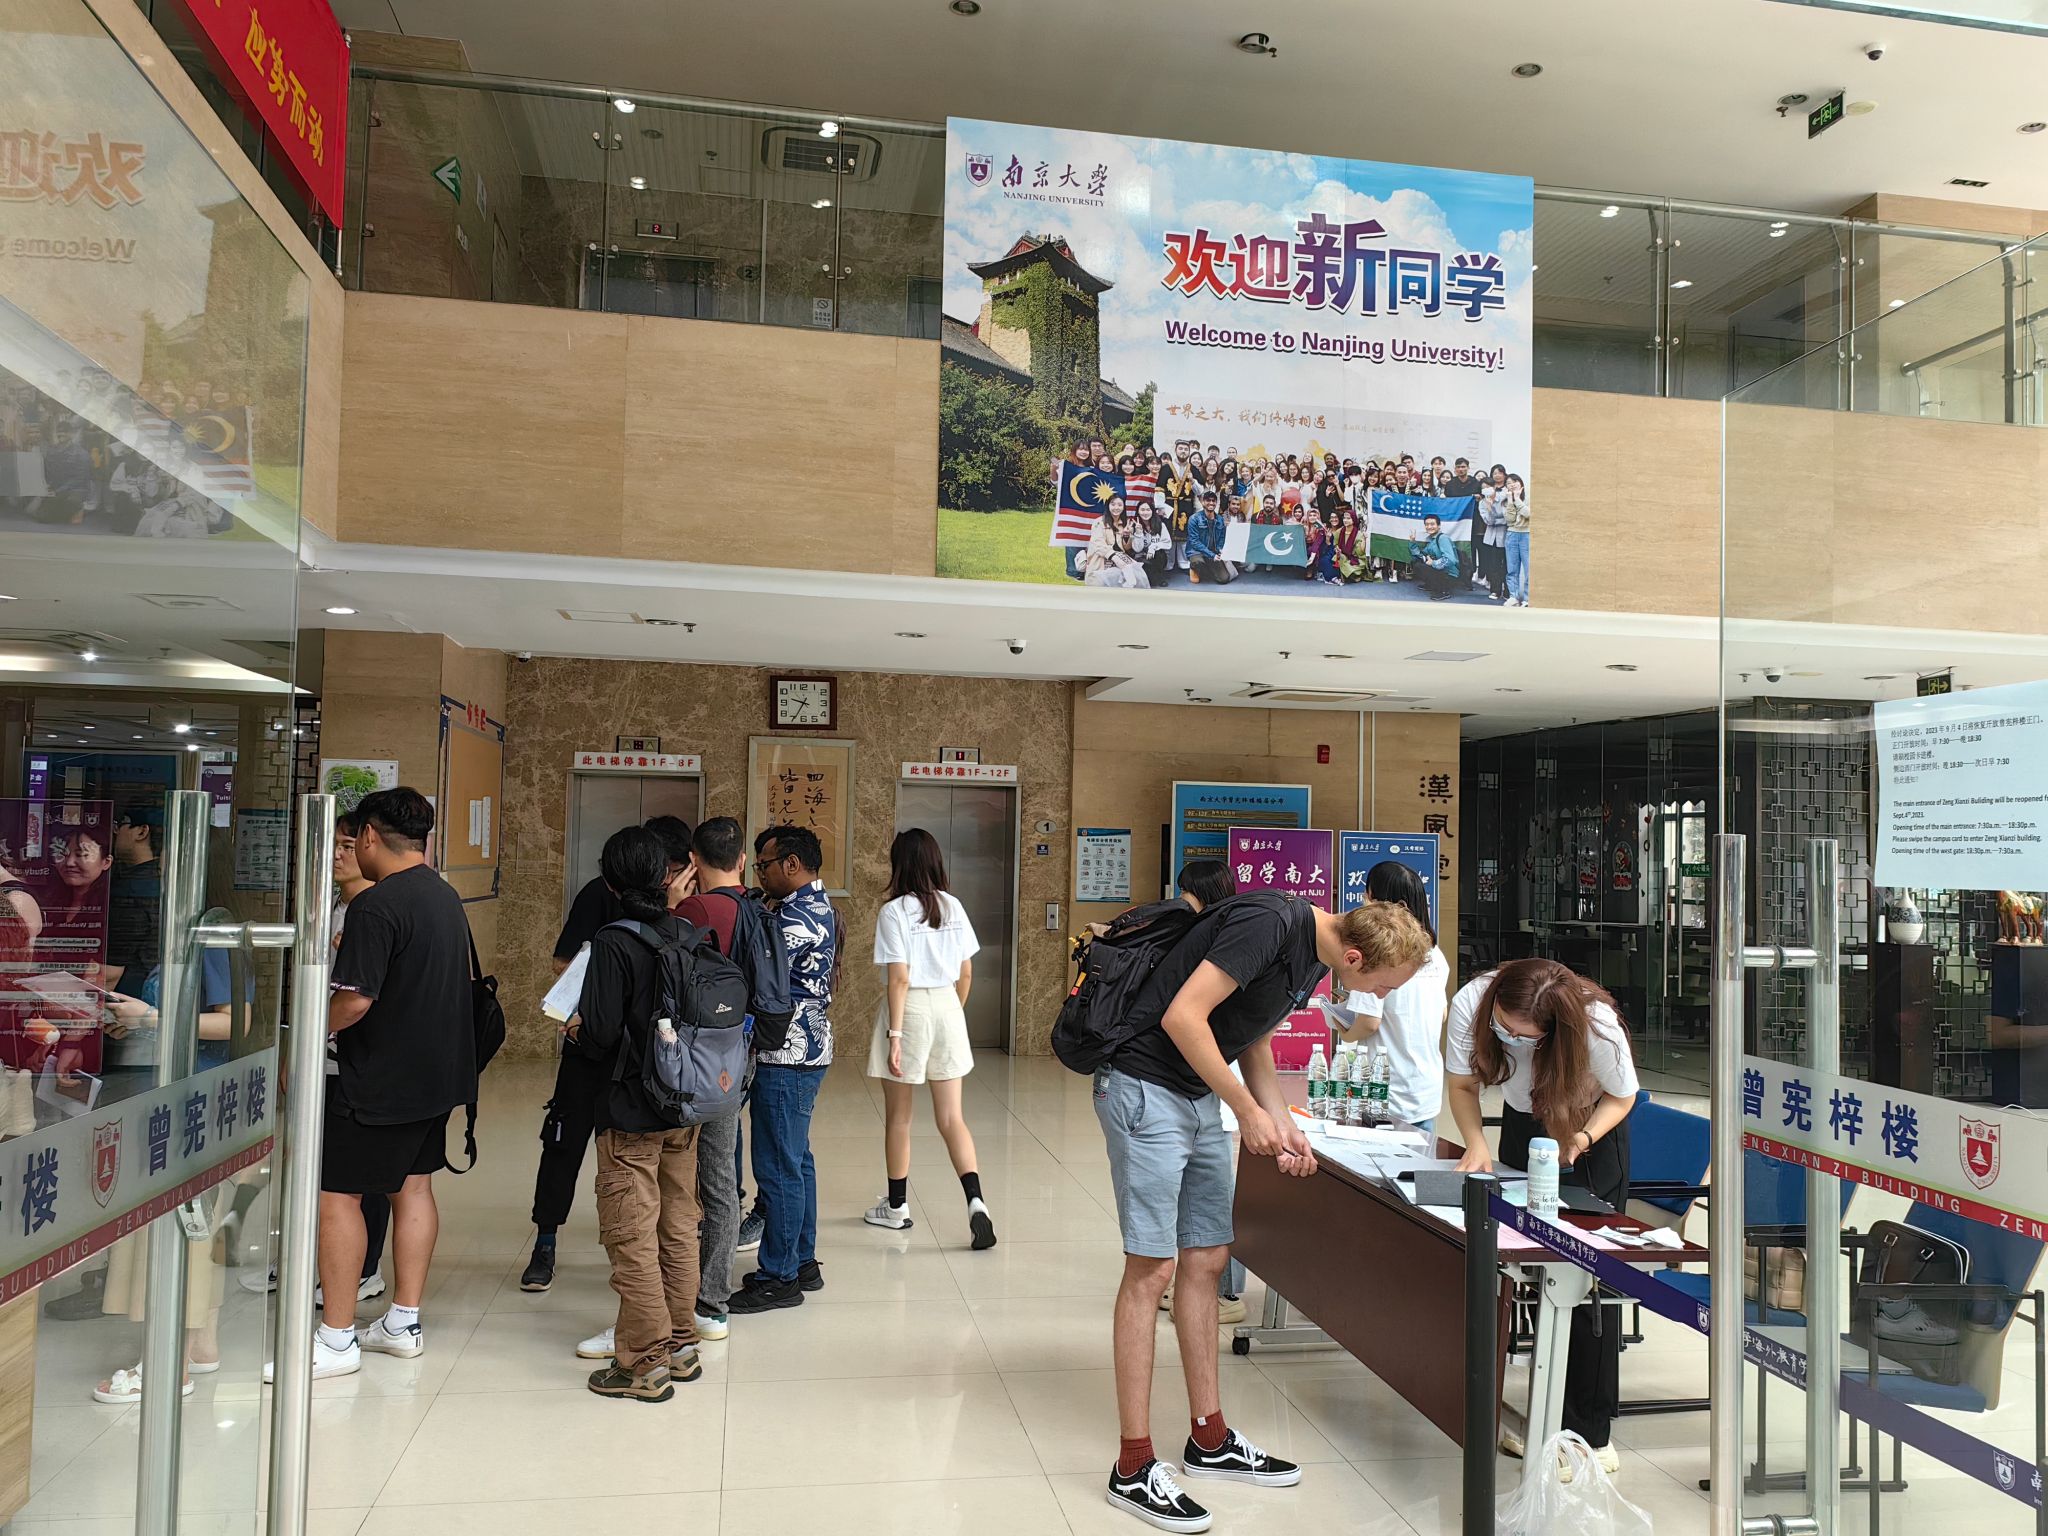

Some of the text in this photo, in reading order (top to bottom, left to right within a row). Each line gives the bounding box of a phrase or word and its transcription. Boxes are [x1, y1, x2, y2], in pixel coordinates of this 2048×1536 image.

[1003, 191, 1105, 207] NANJING UNIVERSITY
[1163, 212, 1506, 321] 欢迎新同学
[1165, 320, 1505, 370] Welcome to Nanjing University!
[910, 765, 1010, 777] 此电梯停靠1F-12F
[1916, 799, 1935, 807] entrance
[2006, 795, 2014, 803] be
[2015, 795, 2043, 804] reopened
[1043, 822, 1050, 832] 1
[1893, 823, 1913, 832] Opening
[1933, 835, 1951, 843] campus
[1952, 834, 1962, 842] card
[1892, 847, 1912, 856] Opening
[1236, 860, 1326, 885] 留学南大
[1299, 888, 1307, 896] at
[1308, 888, 1325, 896] NJU
[149, 1066, 266, 1177] 曾宪梓楼
[1743, 1067, 1919, 1165] 曾宪梓楼
[1781, 1145, 1821, 1169] XIAN
[1833, 1164, 1849, 1178] ZI
[1861, 1170, 1961, 1213] BUILDING
[116, 1203, 153, 1237] ZENG
[163, 1186, 193, 1211] XIAN
[219, 1142, 269, 1180] BUILDING
